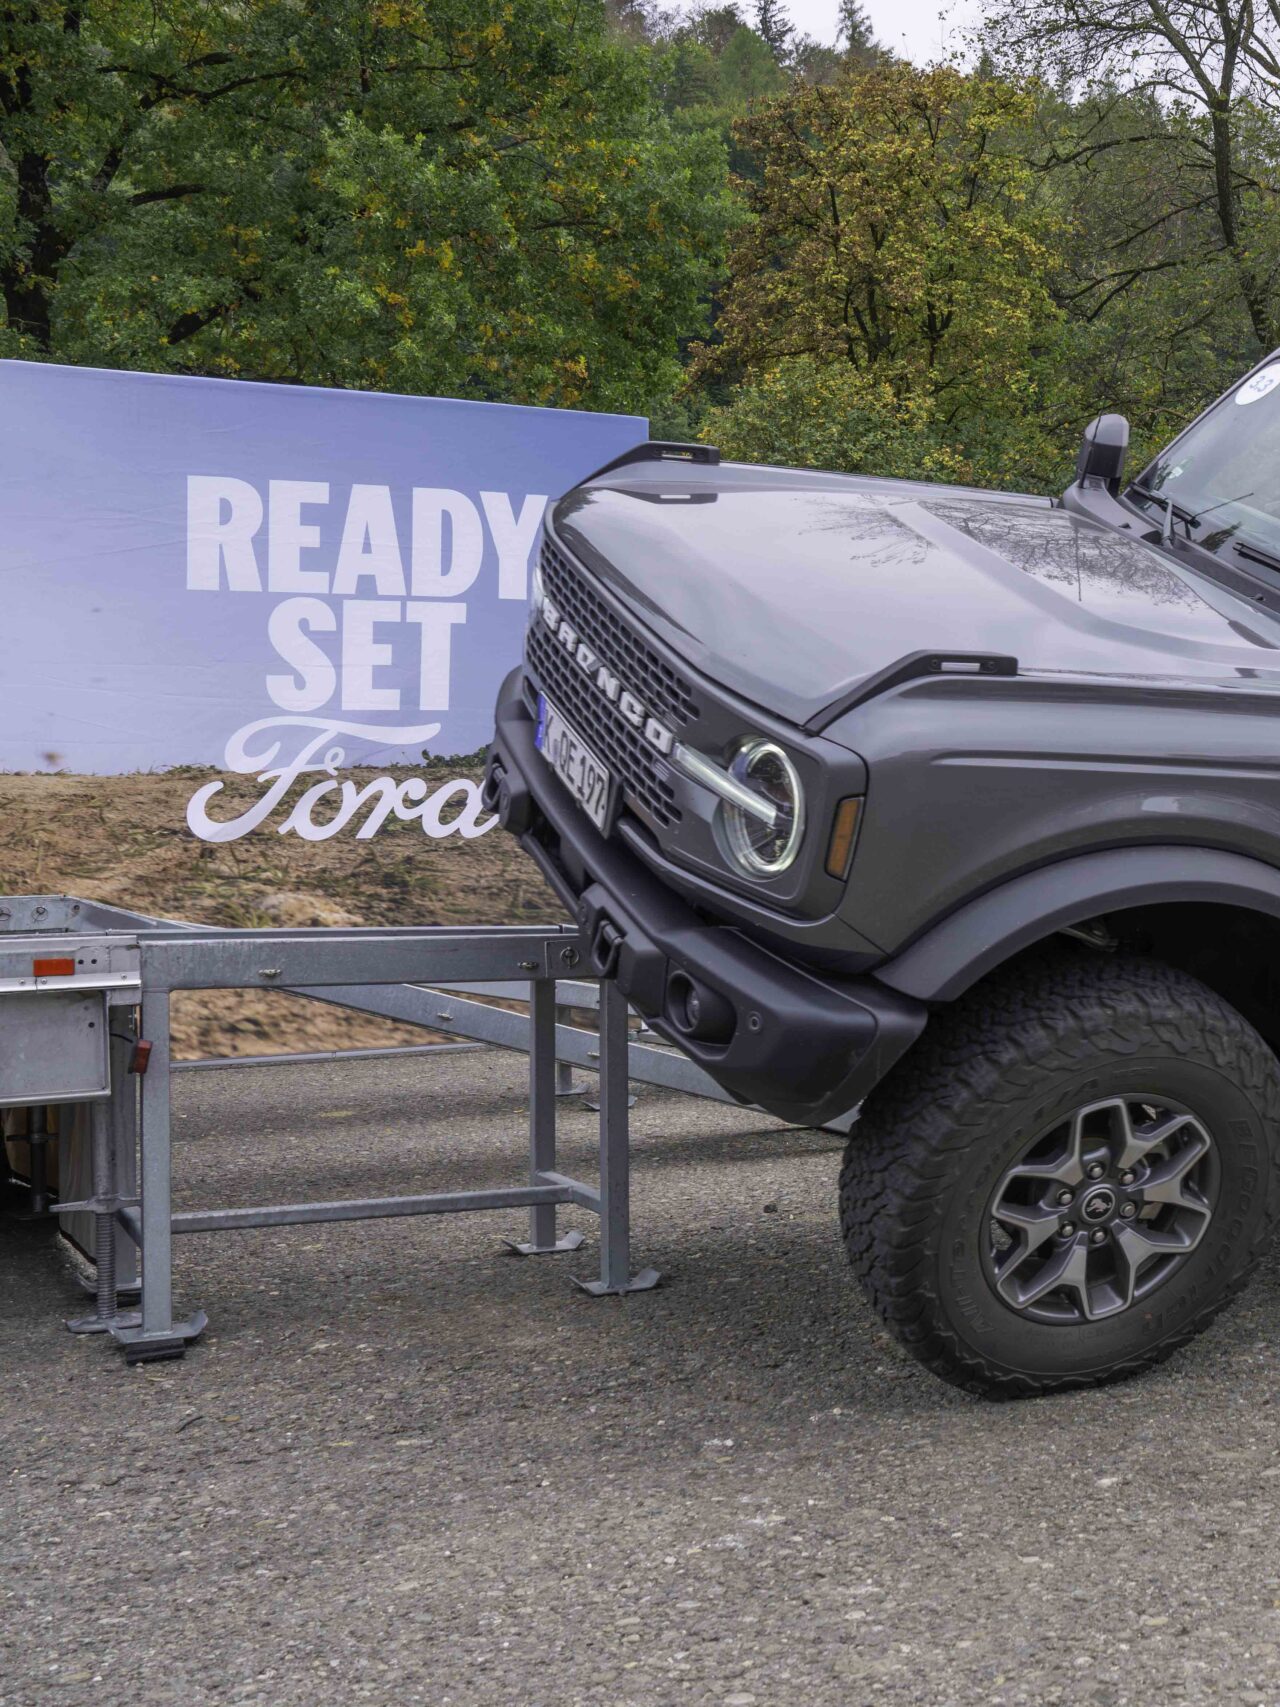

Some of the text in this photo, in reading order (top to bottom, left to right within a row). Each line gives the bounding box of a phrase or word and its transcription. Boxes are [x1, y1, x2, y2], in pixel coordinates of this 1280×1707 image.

[187, 475, 549, 600] READY
[266, 597, 467, 712] SET
[542, 597, 674, 754] BRONCO
[576, 755, 605, 816] 197
